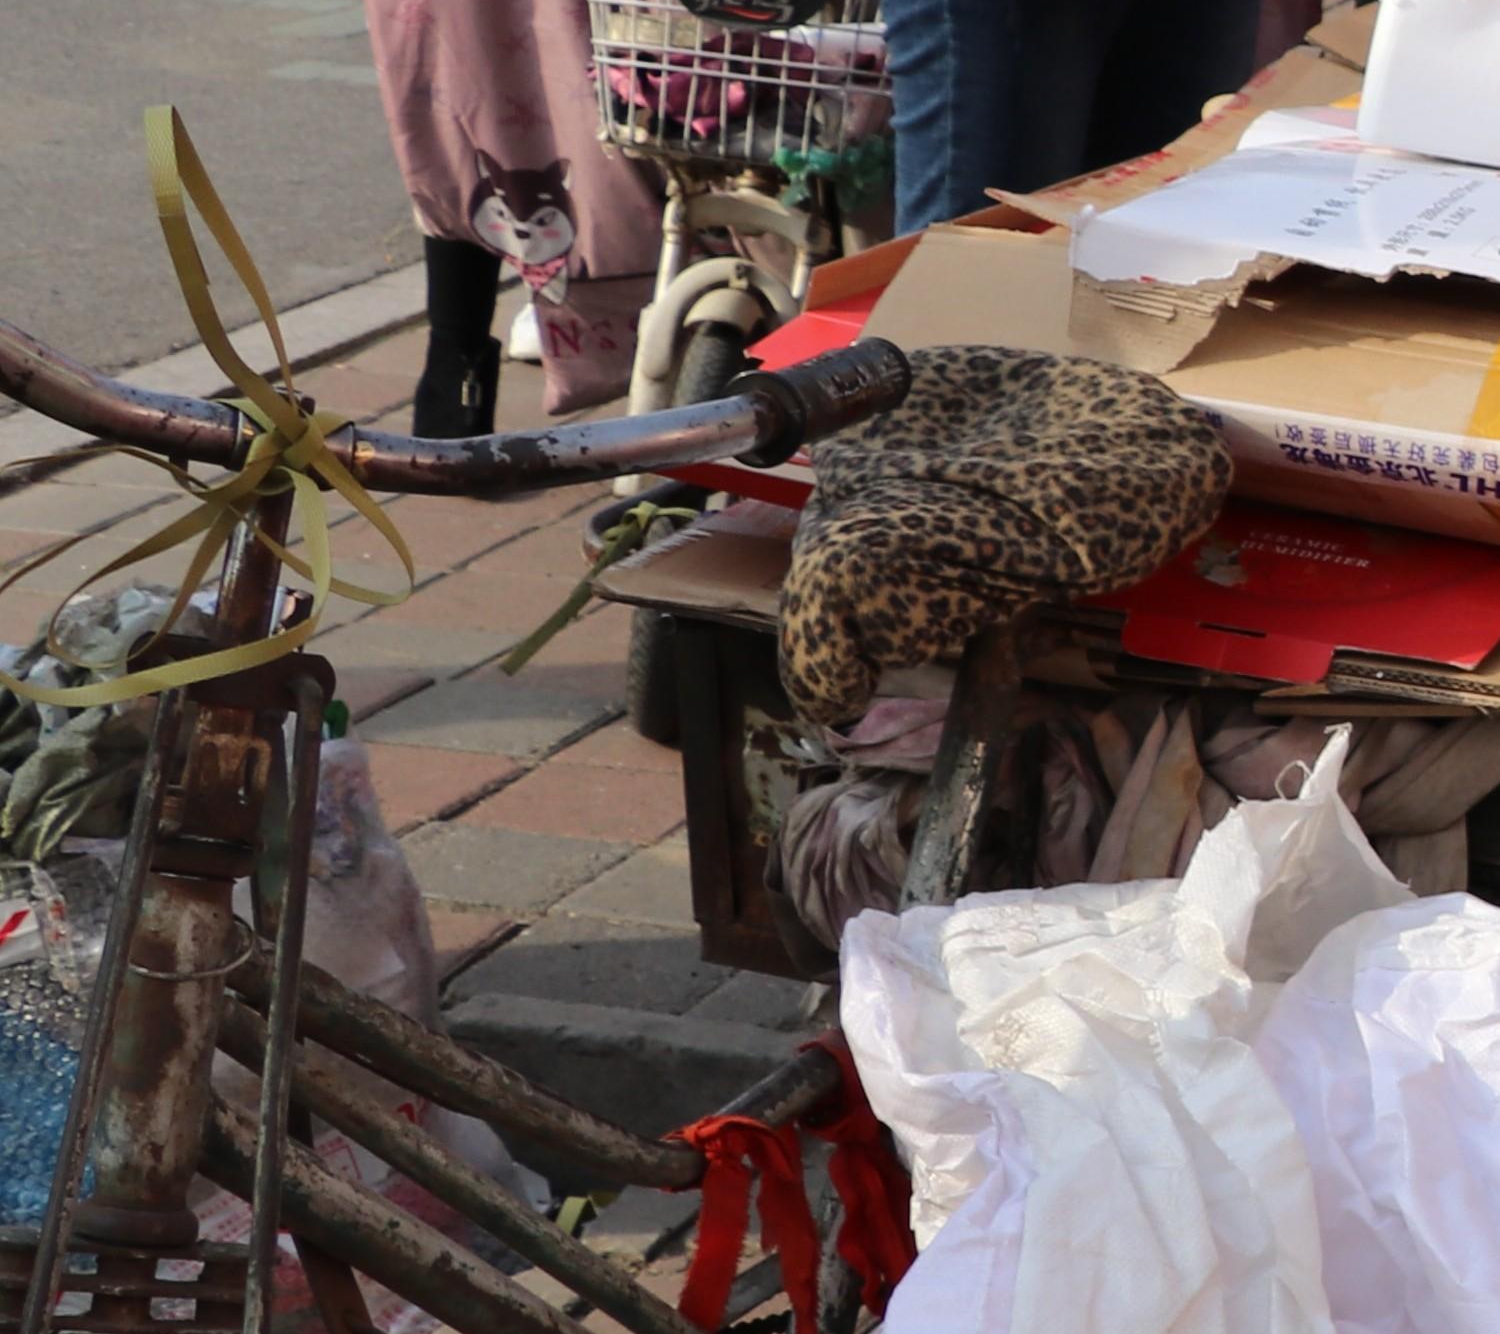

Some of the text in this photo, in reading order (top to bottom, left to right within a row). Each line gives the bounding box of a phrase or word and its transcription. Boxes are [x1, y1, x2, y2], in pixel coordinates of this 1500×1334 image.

[1280, 442, 1439, 488] 北京金海龙
[1239, 539, 1371, 569] HUMIDIFIER
[1248, 529, 1346, 553] CERAMIC
